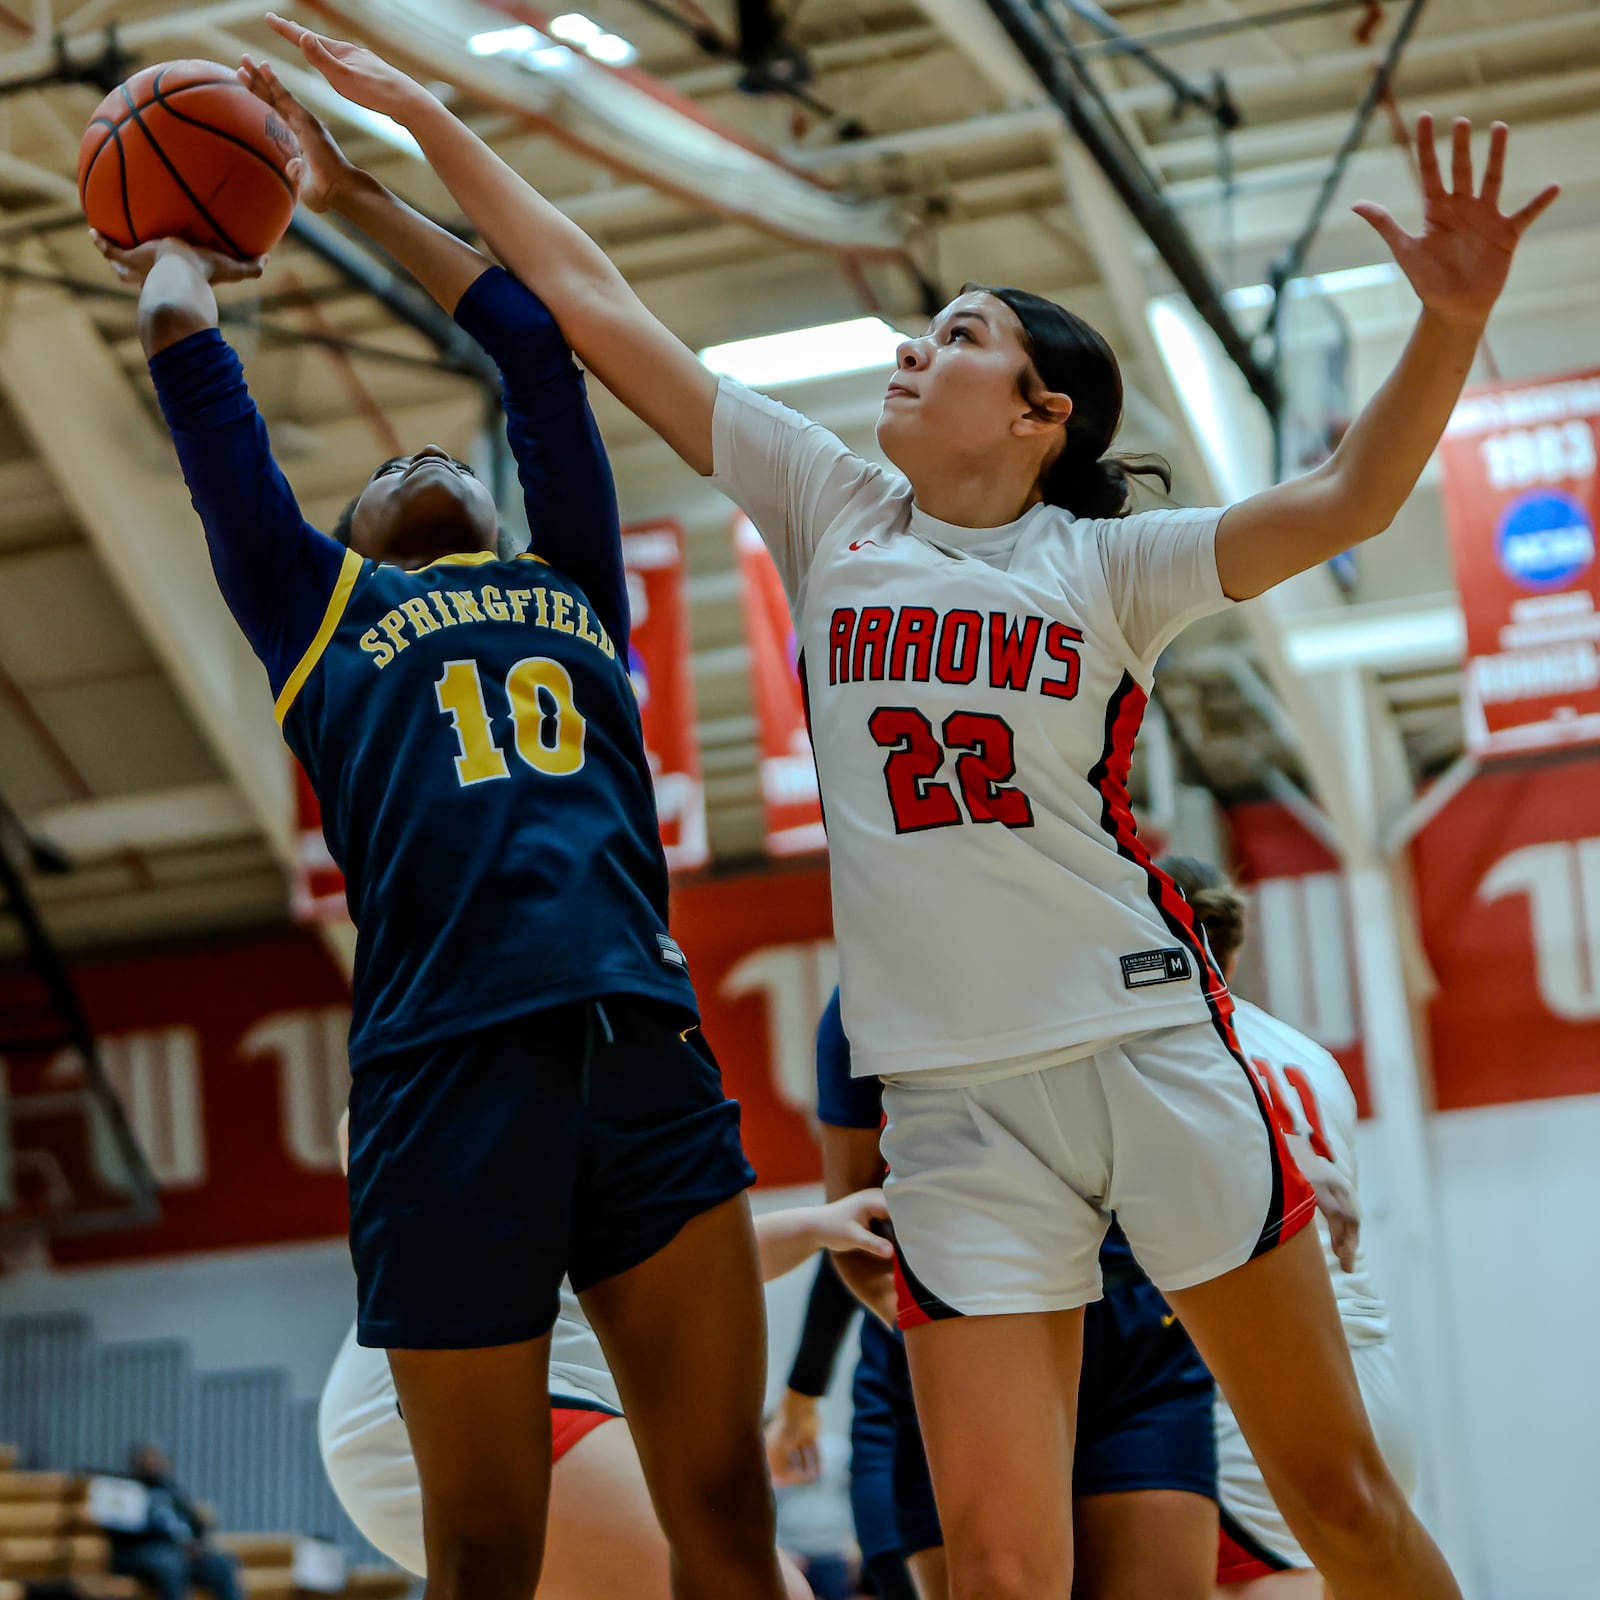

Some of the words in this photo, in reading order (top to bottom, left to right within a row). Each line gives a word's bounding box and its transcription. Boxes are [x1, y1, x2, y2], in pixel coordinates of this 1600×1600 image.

[829, 605, 1084, 701] ARROWS
[434, 656, 586, 787] 10
[867, 706, 1035, 834] 22
[1170, 957, 1183, 972] M
